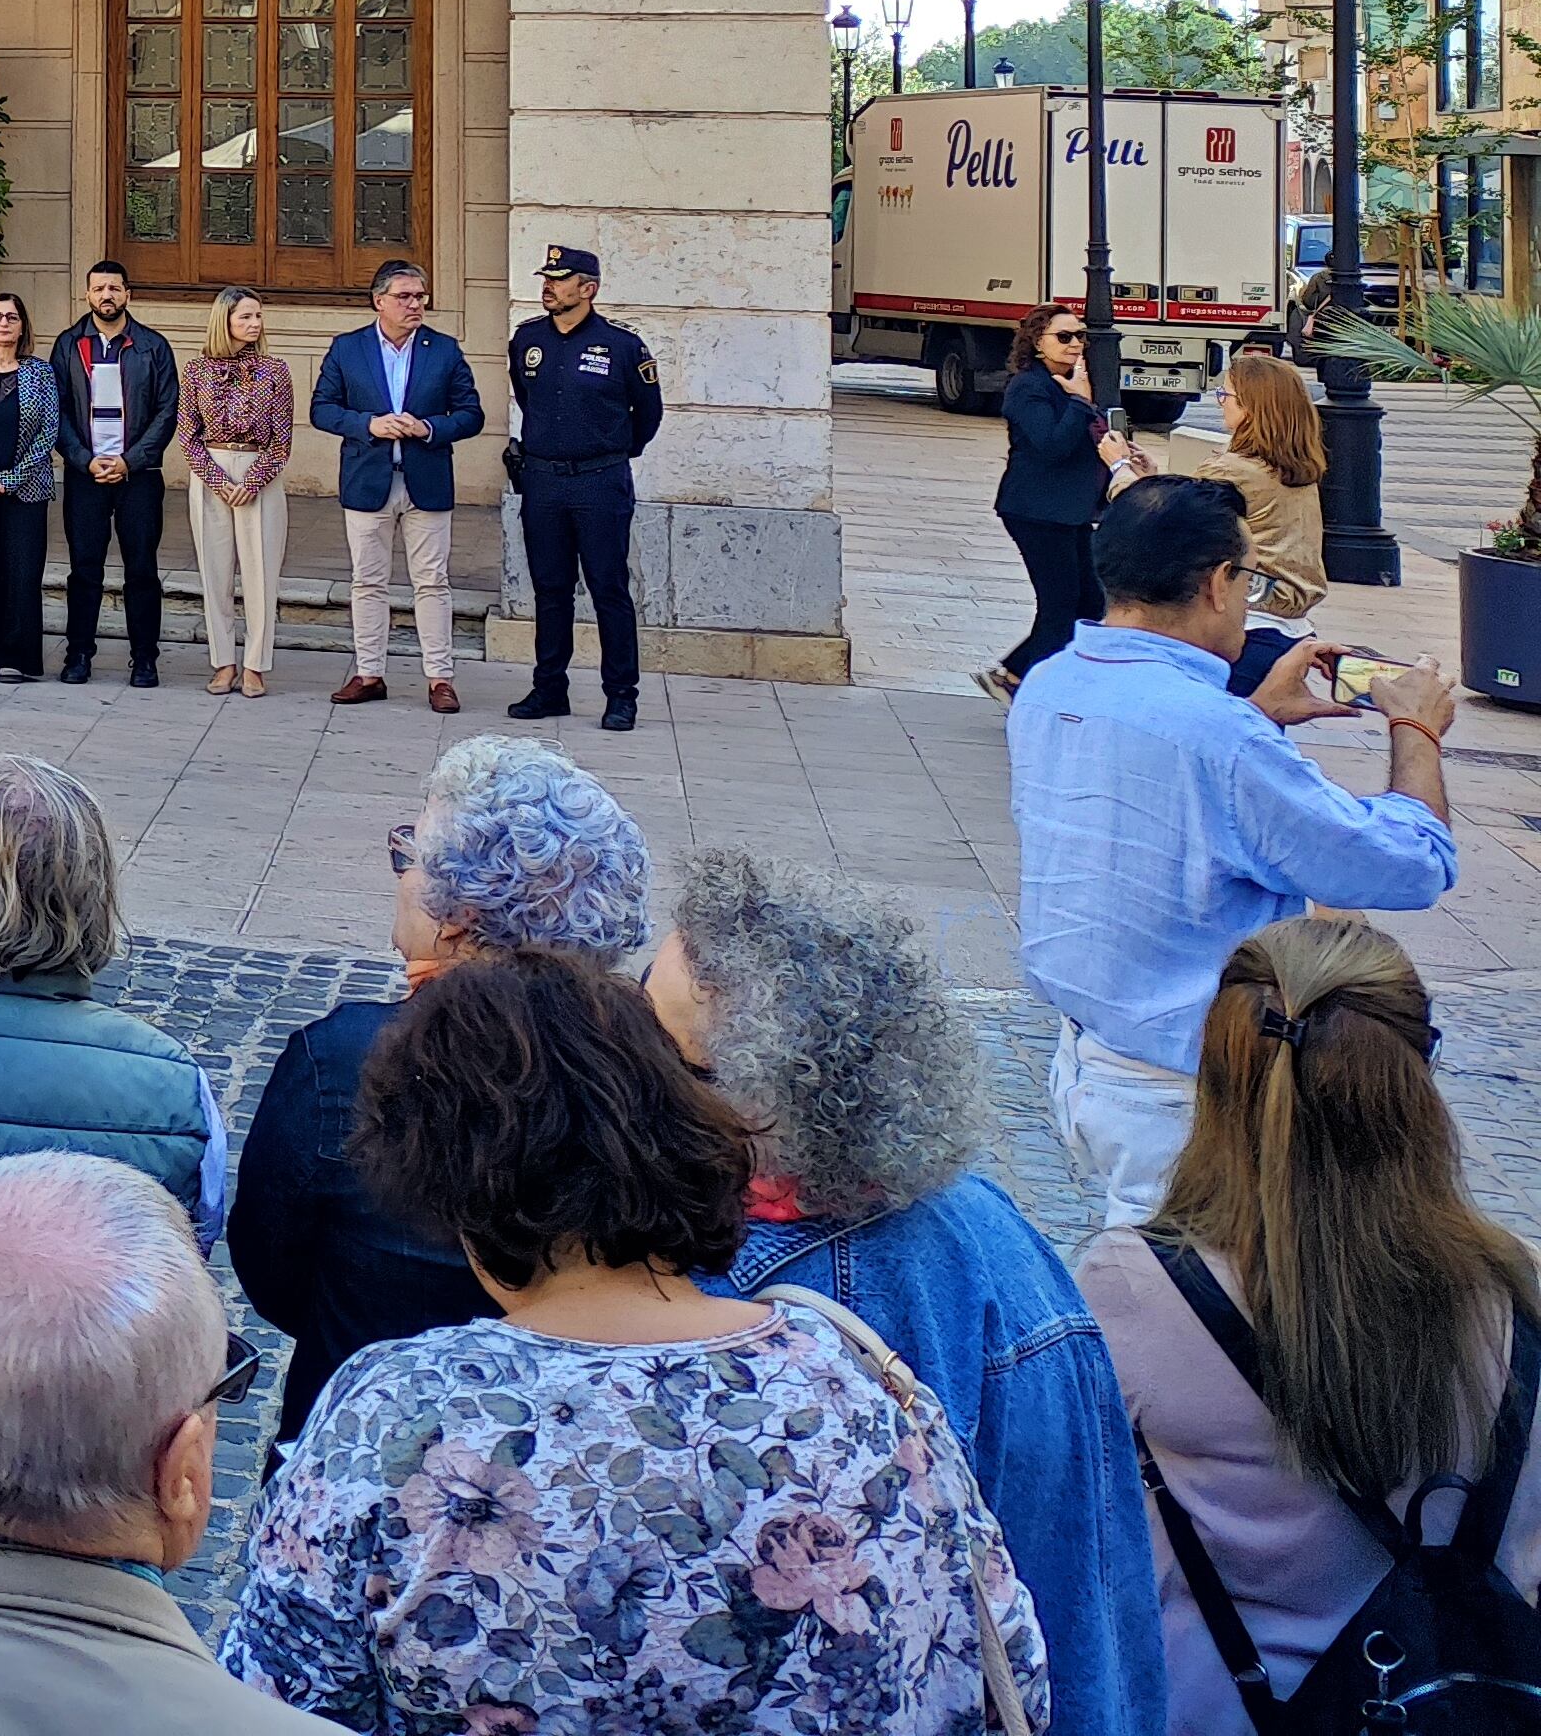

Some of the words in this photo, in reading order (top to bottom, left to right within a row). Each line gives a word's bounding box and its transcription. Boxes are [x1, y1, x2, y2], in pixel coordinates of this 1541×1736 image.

[1065, 127, 1149, 167] Plli
[946, 119, 1018, 189] Pelli
[1177, 166, 1215, 178] grupo
[1219, 166, 1262, 178] serhos
[1179, 306, 1260, 318] gruposerhos.com
[1140, 344, 1183, 356] URBAN
[1162, 377, 1181, 388] MRP
